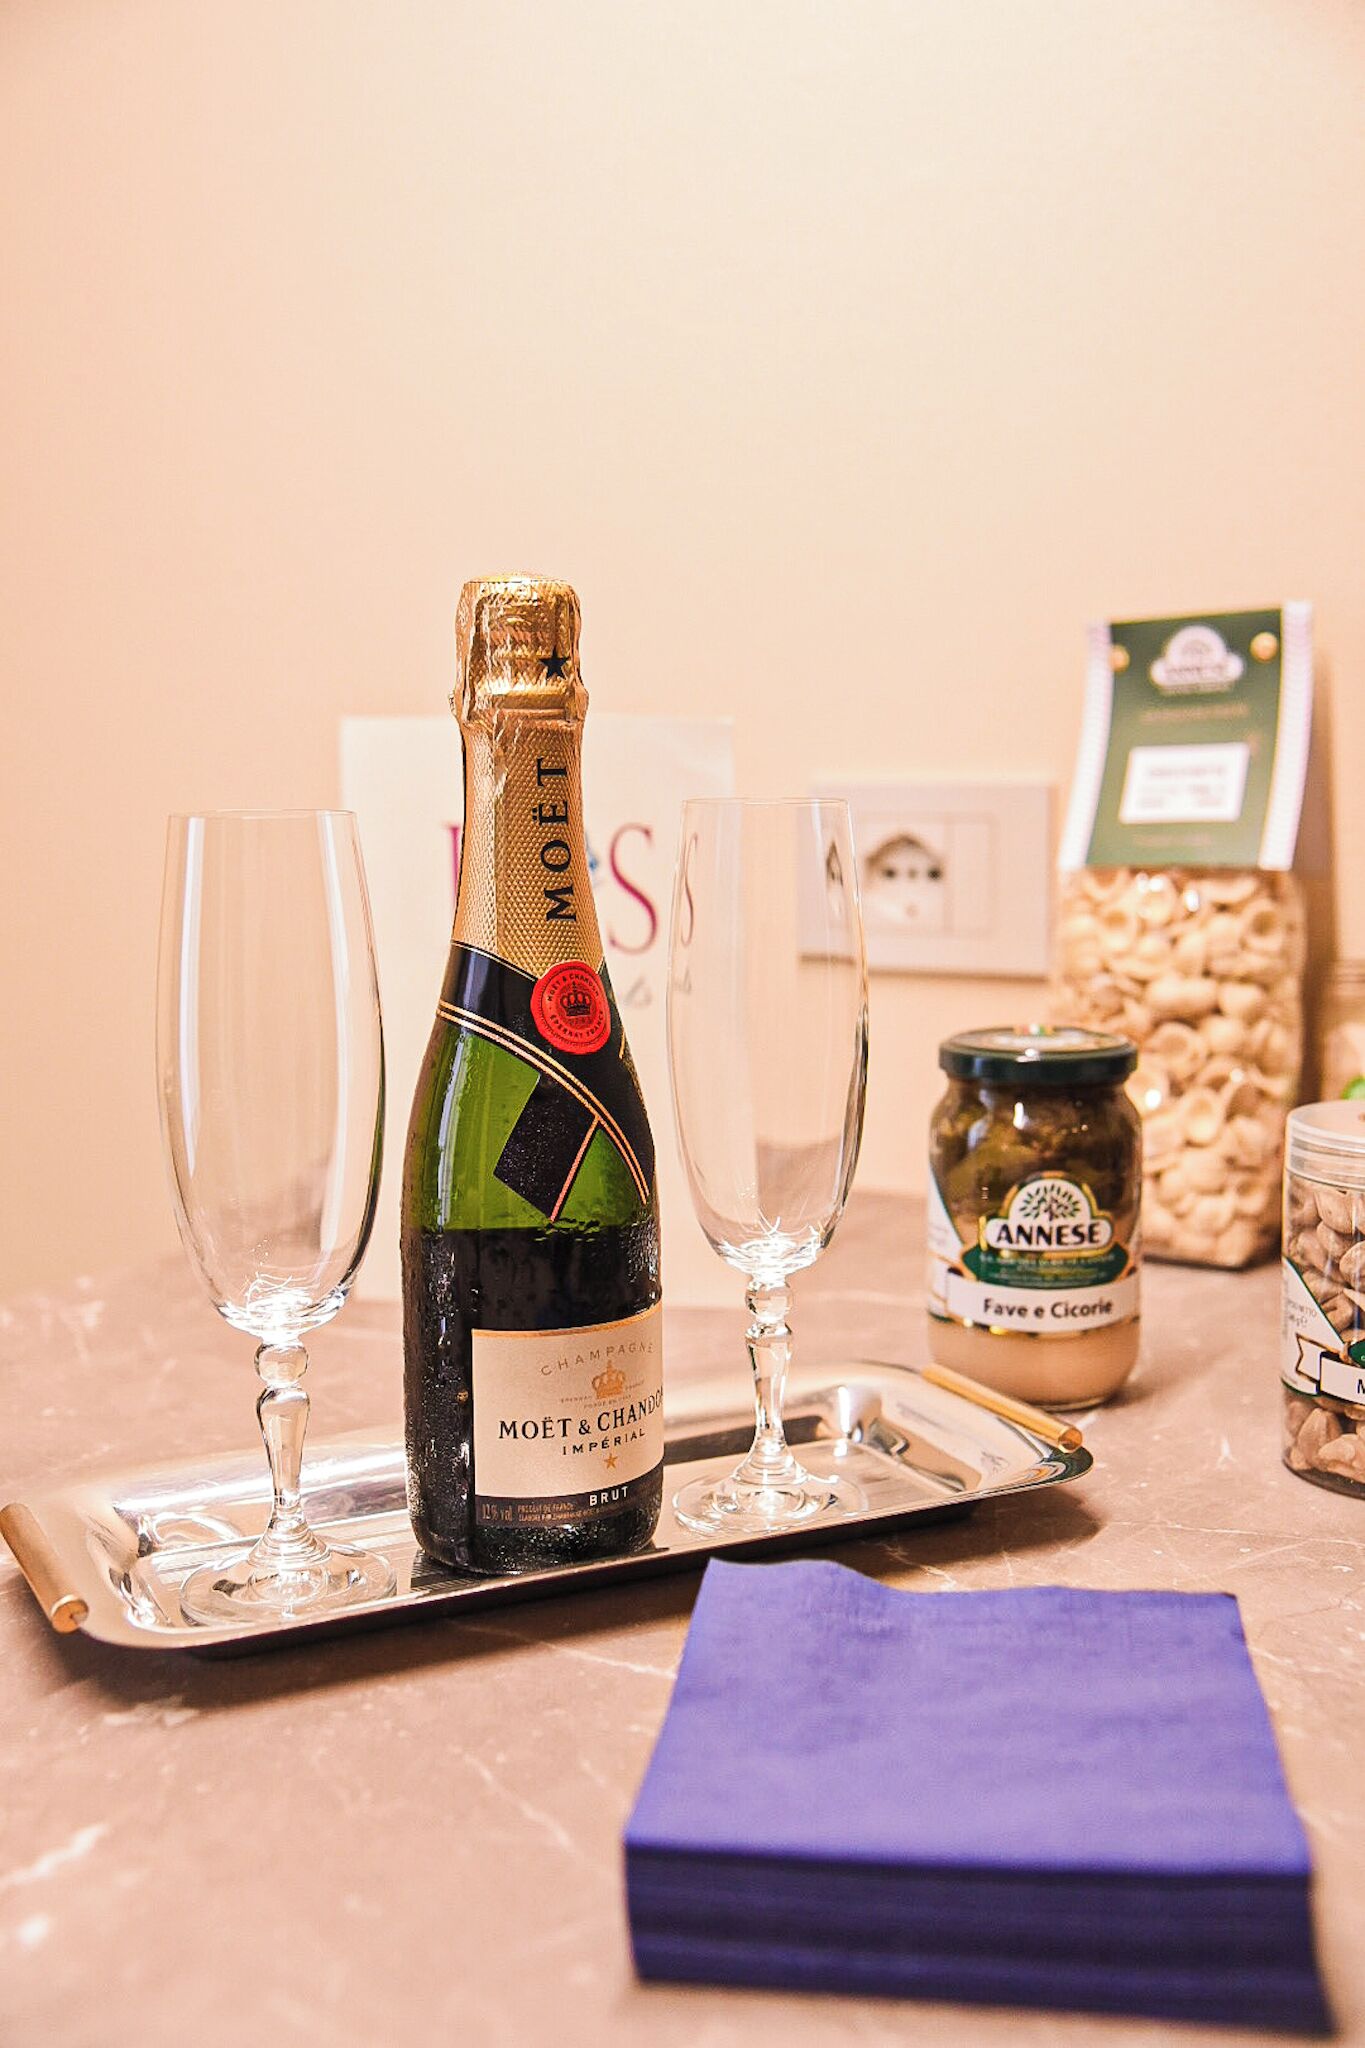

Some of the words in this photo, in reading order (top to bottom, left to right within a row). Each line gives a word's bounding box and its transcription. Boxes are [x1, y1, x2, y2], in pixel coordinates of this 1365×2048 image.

[532, 757, 577, 922] MOËT
[996, 1223, 1100, 1246] ANNESE
[983, 1298, 1028, 1318] Fave
[1034, 1305, 1045, 1318] e
[1050, 1298, 1112, 1318] Cicorie
[541, 1342, 653, 1376] CHAMPAGNE
[499, 1416, 572, 1439] MOËT
[578, 1418, 591, 1435] &
[562, 1428, 646, 1455] IMPÉRIAL
[589, 1486, 628, 1506] BRUT
